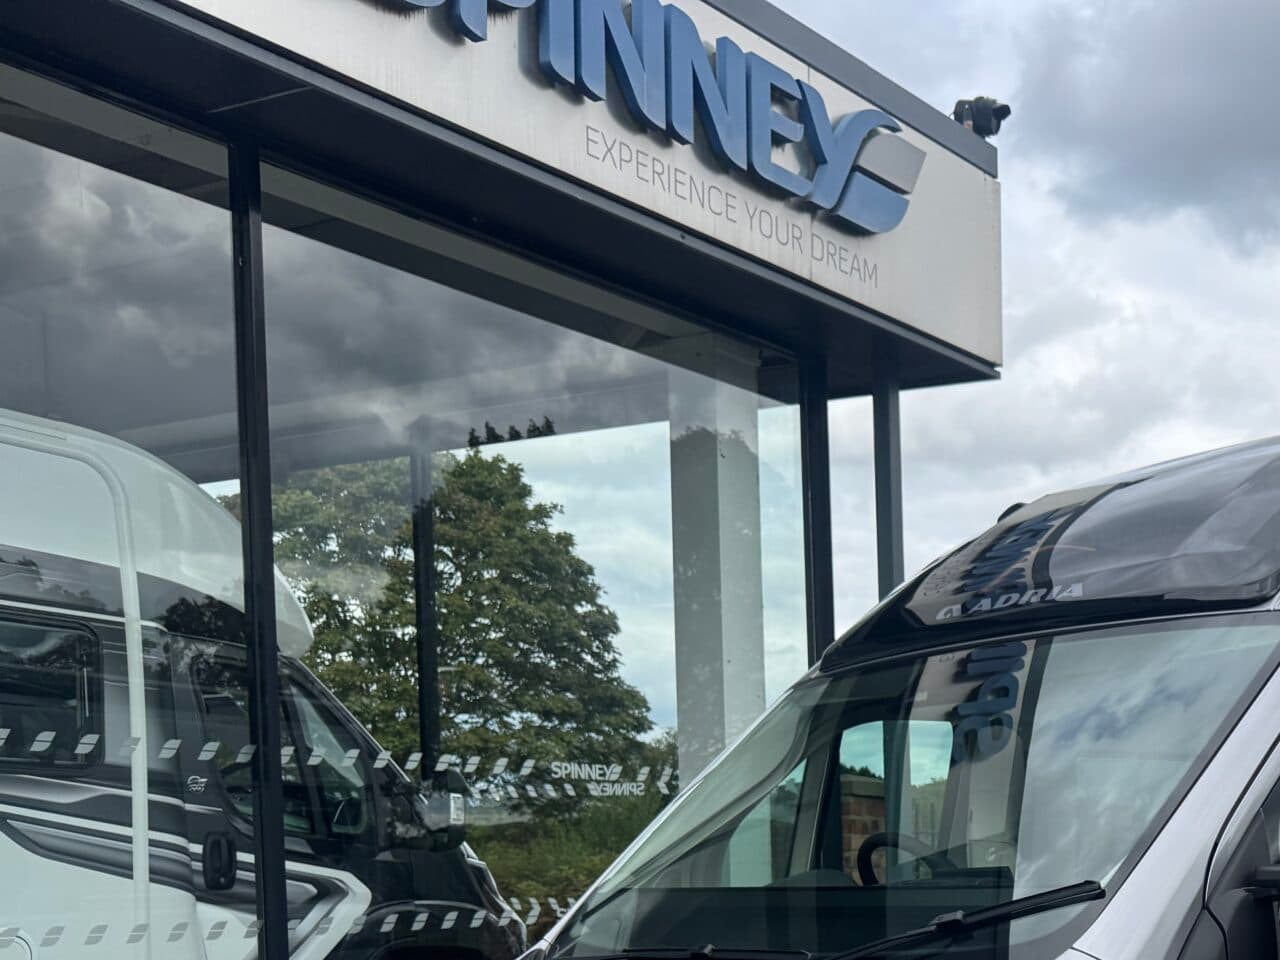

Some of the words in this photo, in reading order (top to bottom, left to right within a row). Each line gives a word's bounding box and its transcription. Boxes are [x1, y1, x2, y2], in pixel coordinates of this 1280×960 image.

[585, 125, 737, 224] EXPERIENCE
[745, 200, 804, 255] YOUR
[811, 232, 879, 289] DREAM
[967, 582, 1084, 615] ADRIA
[551, 761, 616, 781] SPINNEY
